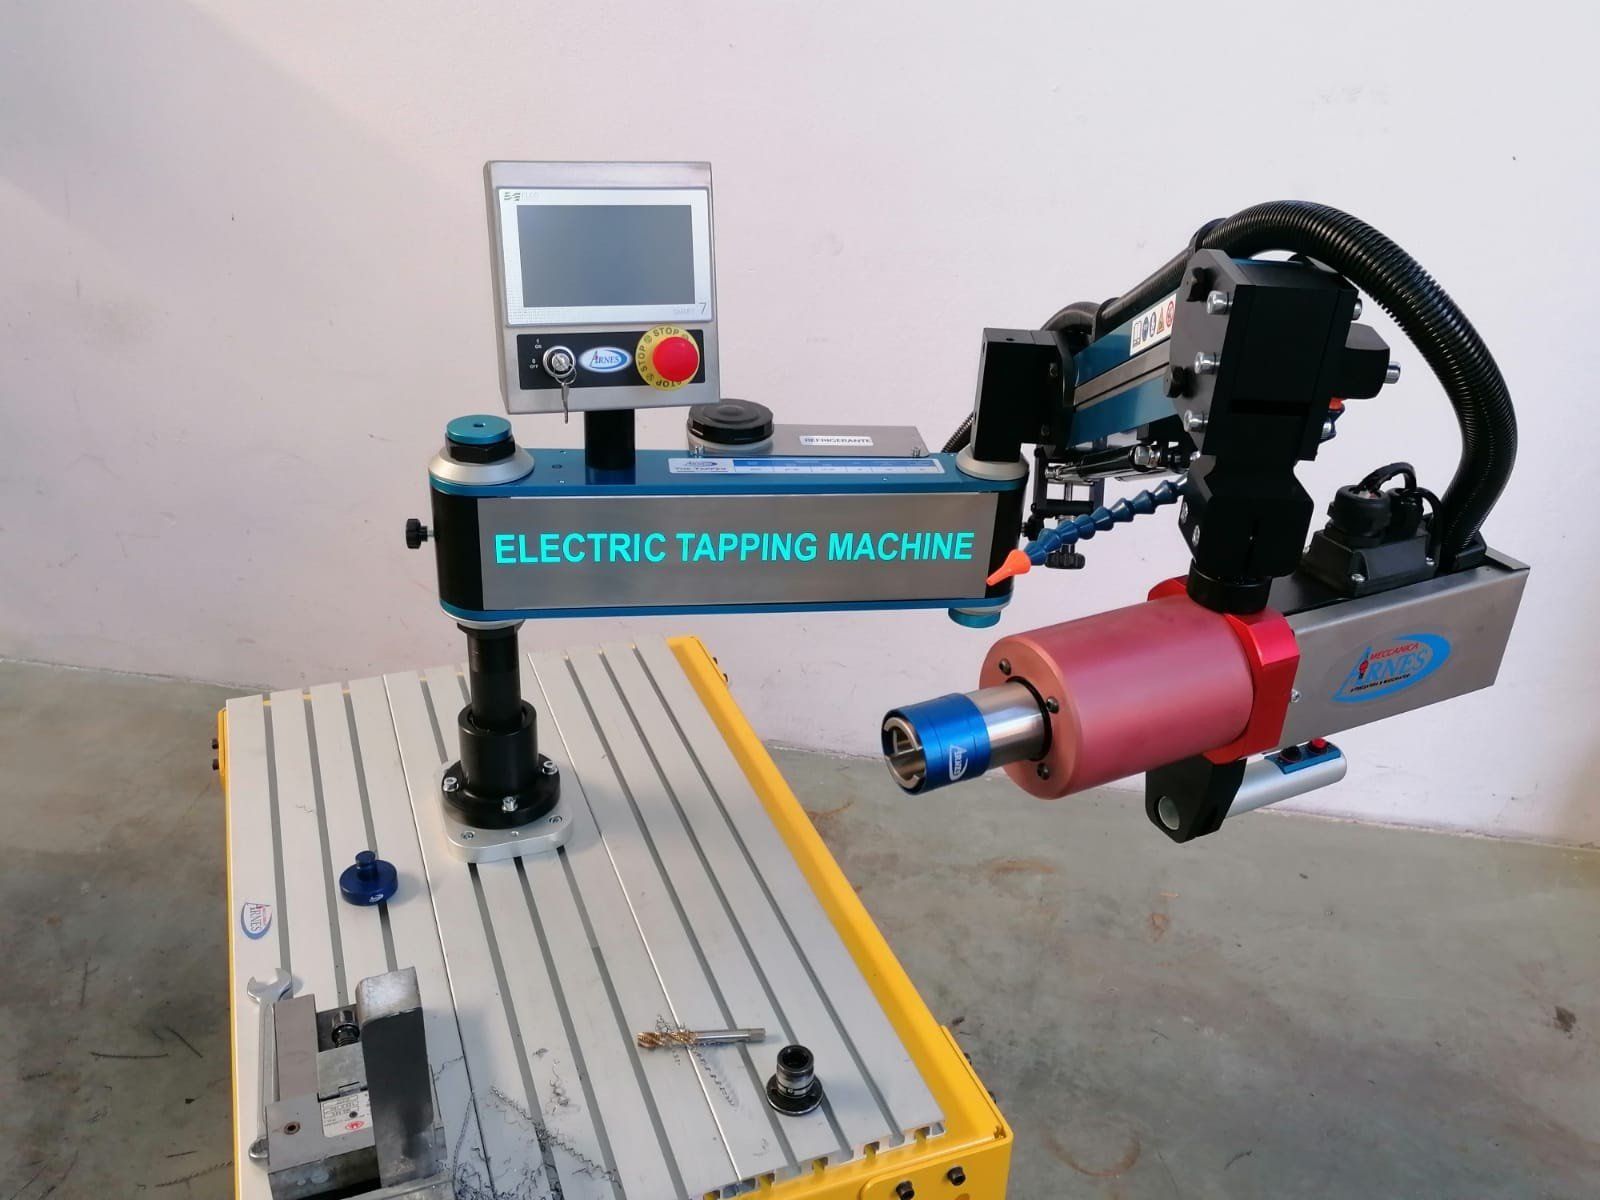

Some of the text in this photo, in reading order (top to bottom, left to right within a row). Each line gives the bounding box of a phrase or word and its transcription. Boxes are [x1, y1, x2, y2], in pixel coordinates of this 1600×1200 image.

[653, 327, 680, 337] STOP
[590, 349, 620, 368] ARNES
[638, 345, 648, 372] STOP
[804, 436, 870, 444] REFRIGERANTE
[494, 531, 974, 564] ELECTRIC TAPPING MACHINE
[1370, 641, 1421, 660] MECCANICA
[1342, 646, 1428, 690] ARNES
